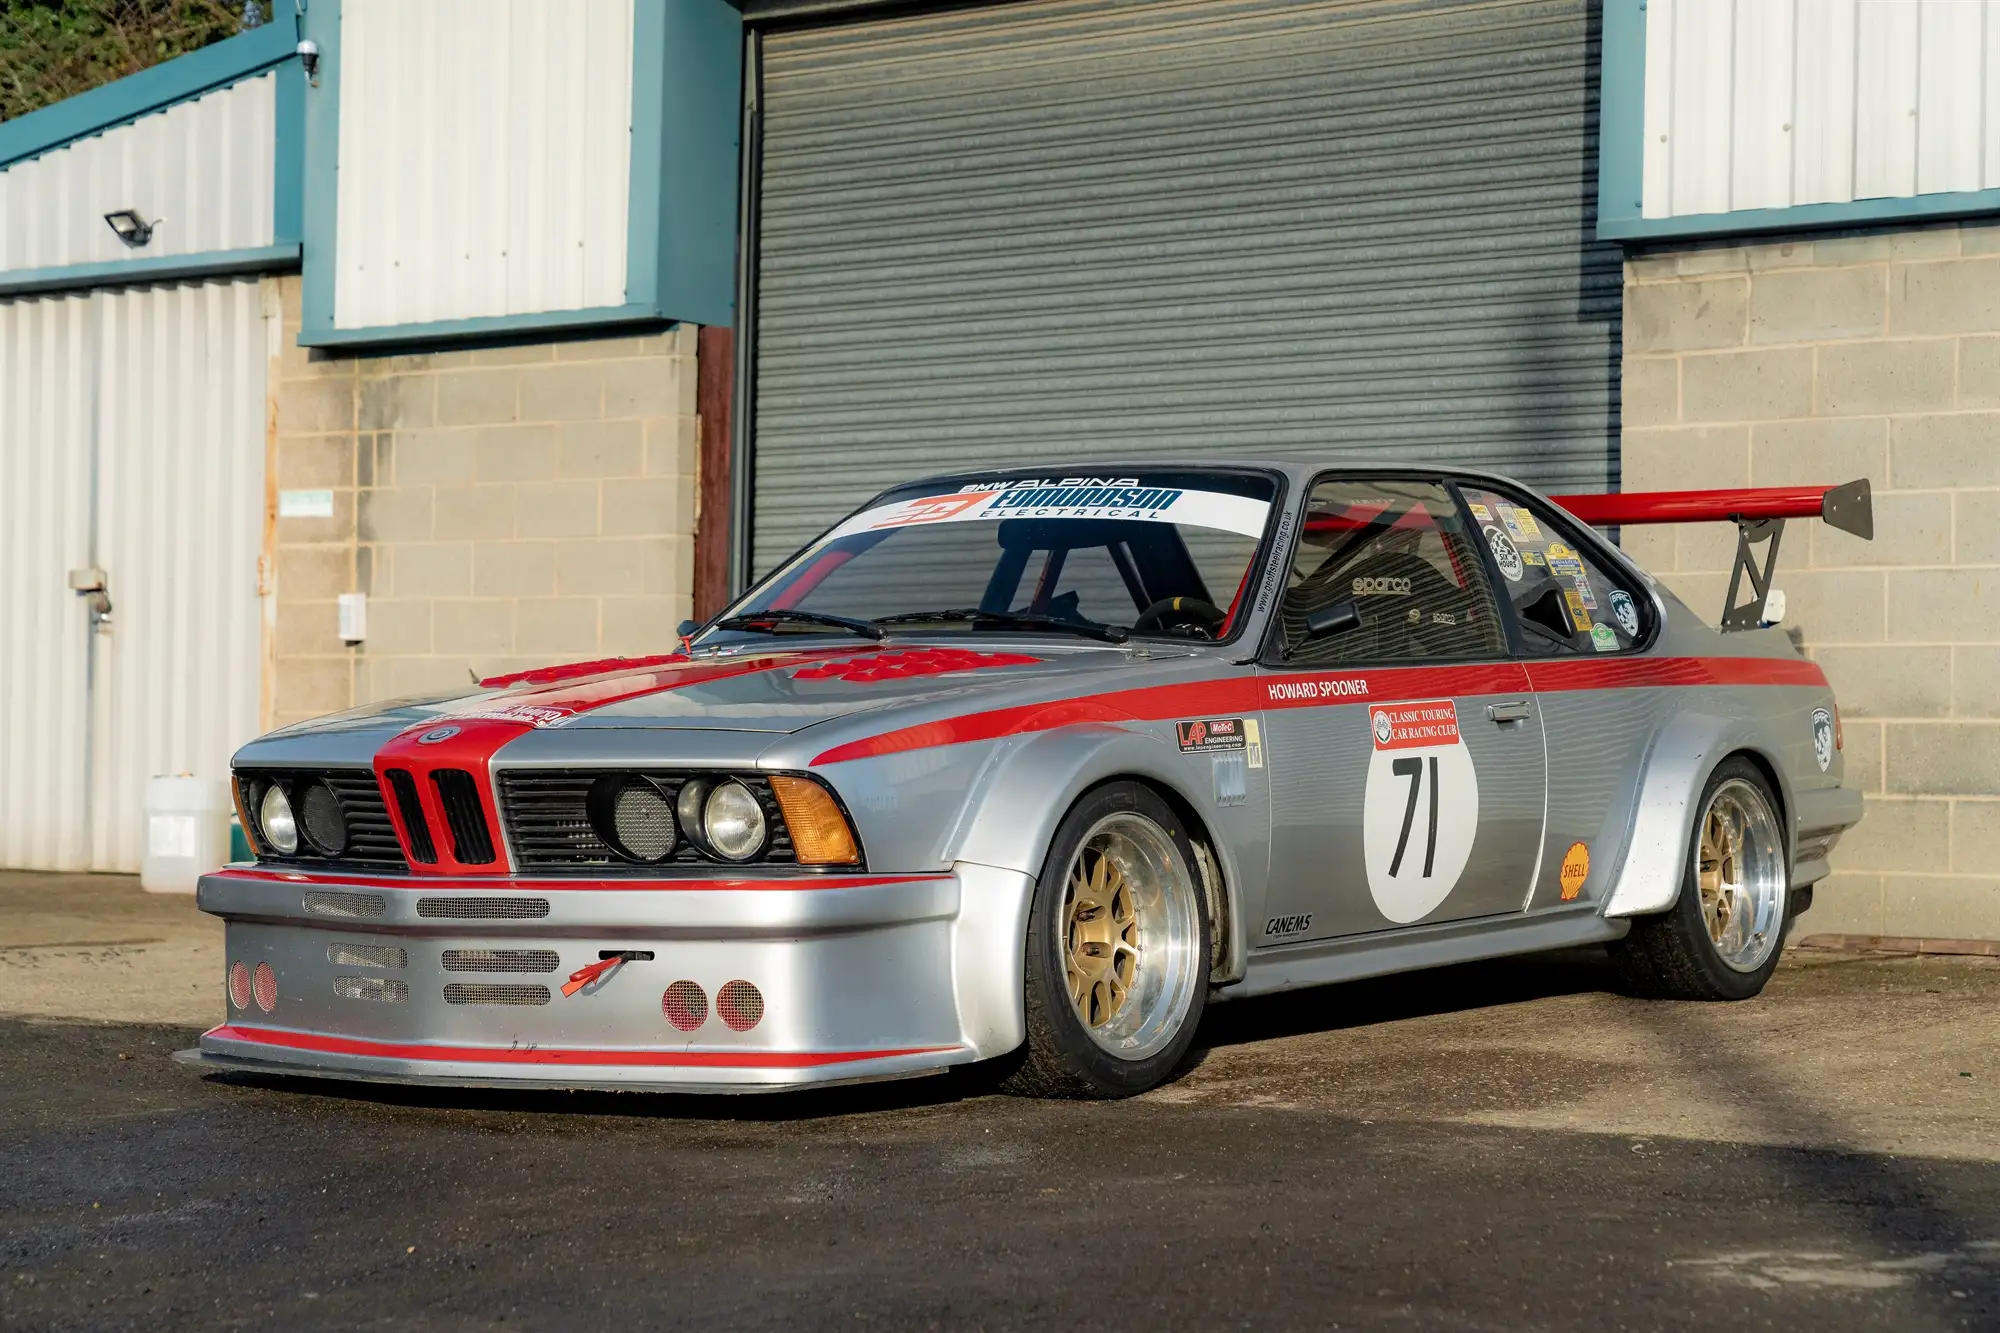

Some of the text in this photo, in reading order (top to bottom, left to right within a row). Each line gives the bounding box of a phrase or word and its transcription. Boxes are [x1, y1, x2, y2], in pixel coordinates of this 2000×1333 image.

[958, 478, 1140, 493] BMW ALPINA
[989, 487, 1183, 510] EDMUNDSON
[980, 509, 1160, 519] ELECTRICAL
[1257, 510, 1293, 613] www.geoffsteelracing.co.uk
[1499, 560, 1517, 568] HOURS
[1352, 577, 1411, 596] sparco
[1611, 593, 1630, 602] BARC
[1432, 613, 1456, 625] sparco
[1268, 679, 1368, 699] HOWARD SPOONER
[1389, 708, 1454, 723] CLASSIC TOURING
[1177, 721, 1207, 746] LAP
[1204, 735, 1243, 744] ENGINEERING
[1392, 724, 1457, 740] CAR RACING CLUB
[1183, 743, 1242, 751] www.lapengineering.com
[1387, 756, 1439, 879] 71
[1563, 863, 1586, 878] SHELL
[1265, 915, 1312, 935] CANEMS
